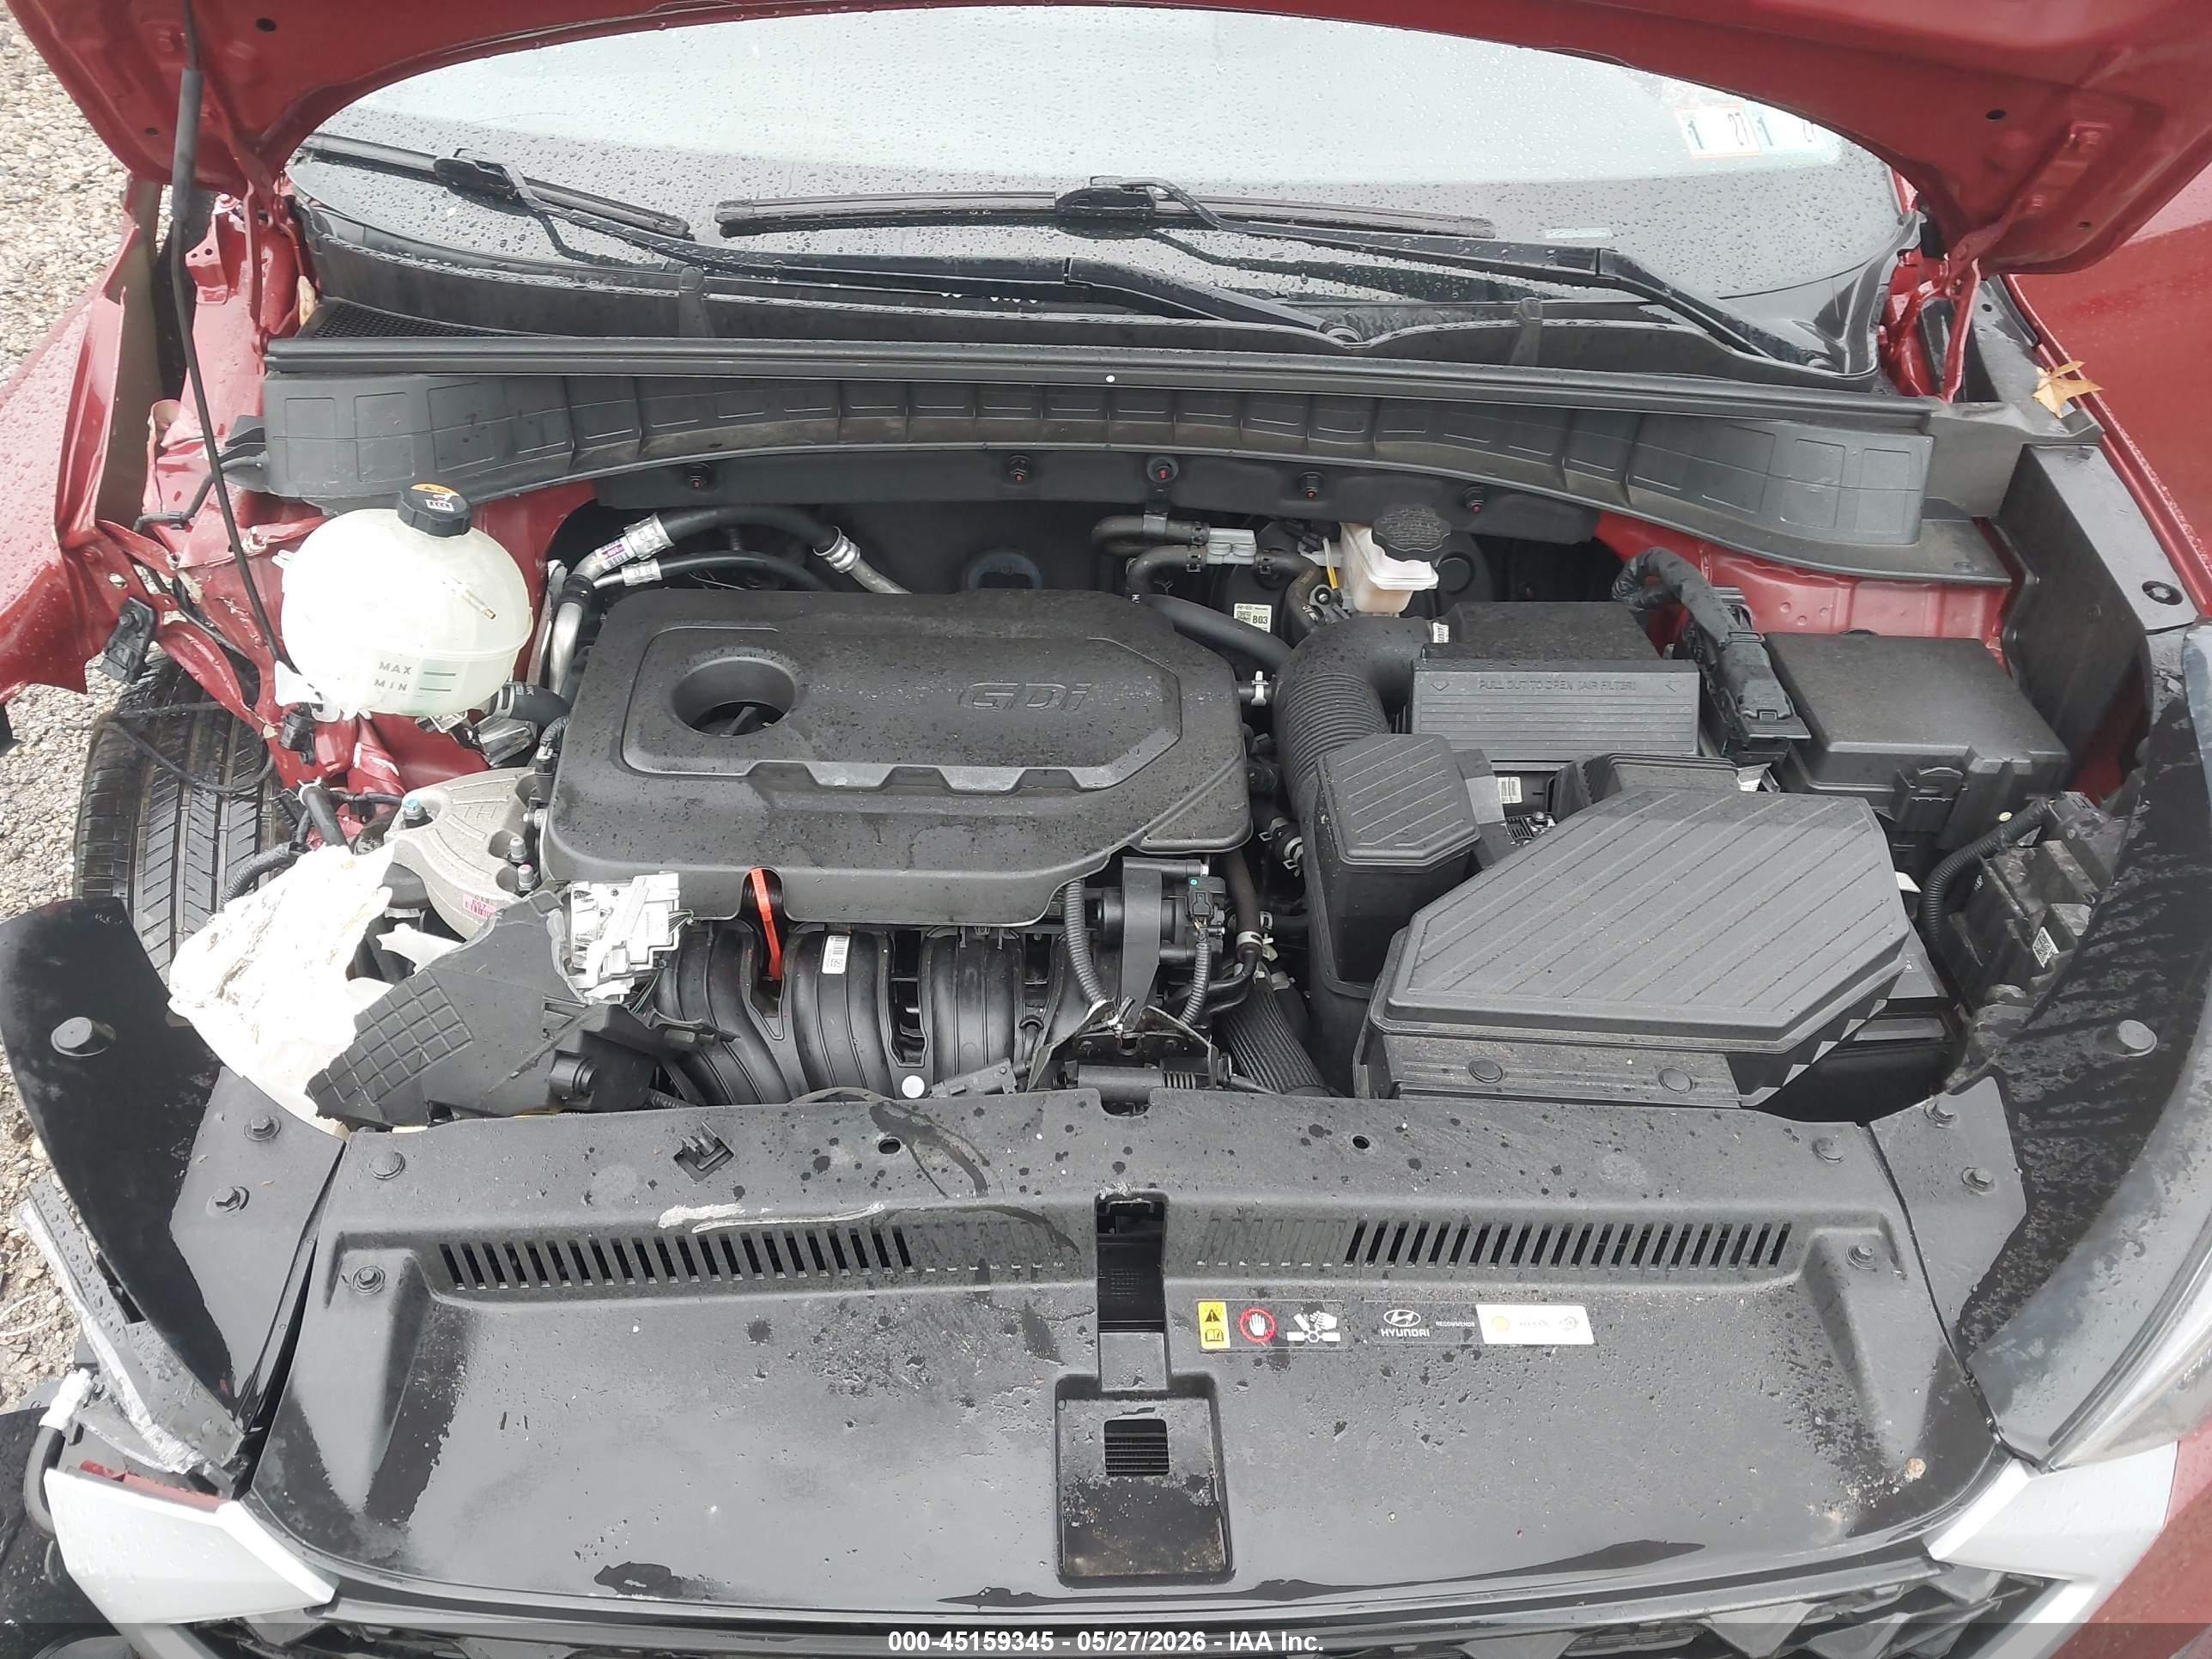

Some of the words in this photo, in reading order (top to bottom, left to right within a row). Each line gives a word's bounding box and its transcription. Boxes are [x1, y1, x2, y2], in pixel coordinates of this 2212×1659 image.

[379, 661, 412, 675] MAX
[374, 678, 408, 691] MIN
[1380, 1328, 1431, 1338] HYUNDAI
